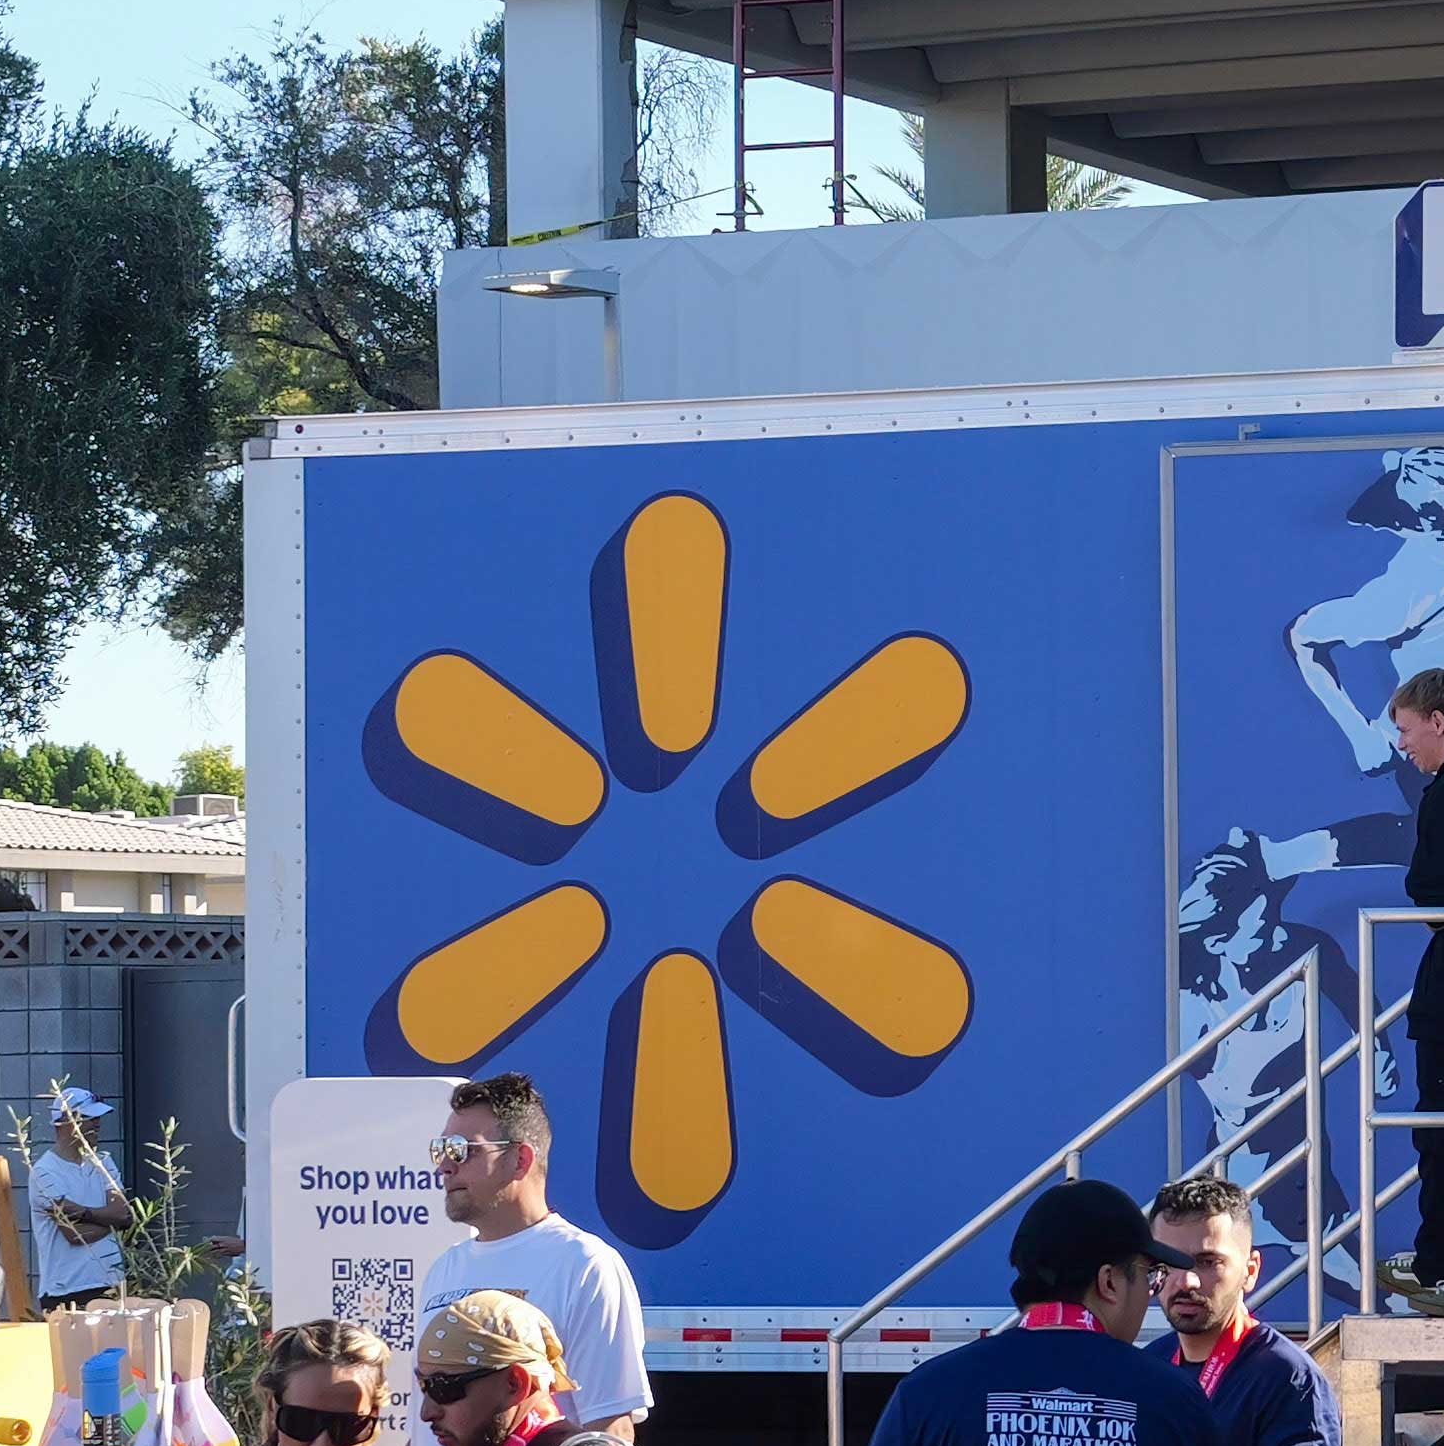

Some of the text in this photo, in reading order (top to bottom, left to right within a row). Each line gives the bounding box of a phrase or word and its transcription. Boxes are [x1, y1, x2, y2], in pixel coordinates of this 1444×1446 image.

[299, 1164, 444, 1195] Shop what
[316, 1200, 429, 1229] you love
[1031, 1397, 1094, 1413] Walmart
[986, 1412, 1137, 1442] PHOENIX 10K
